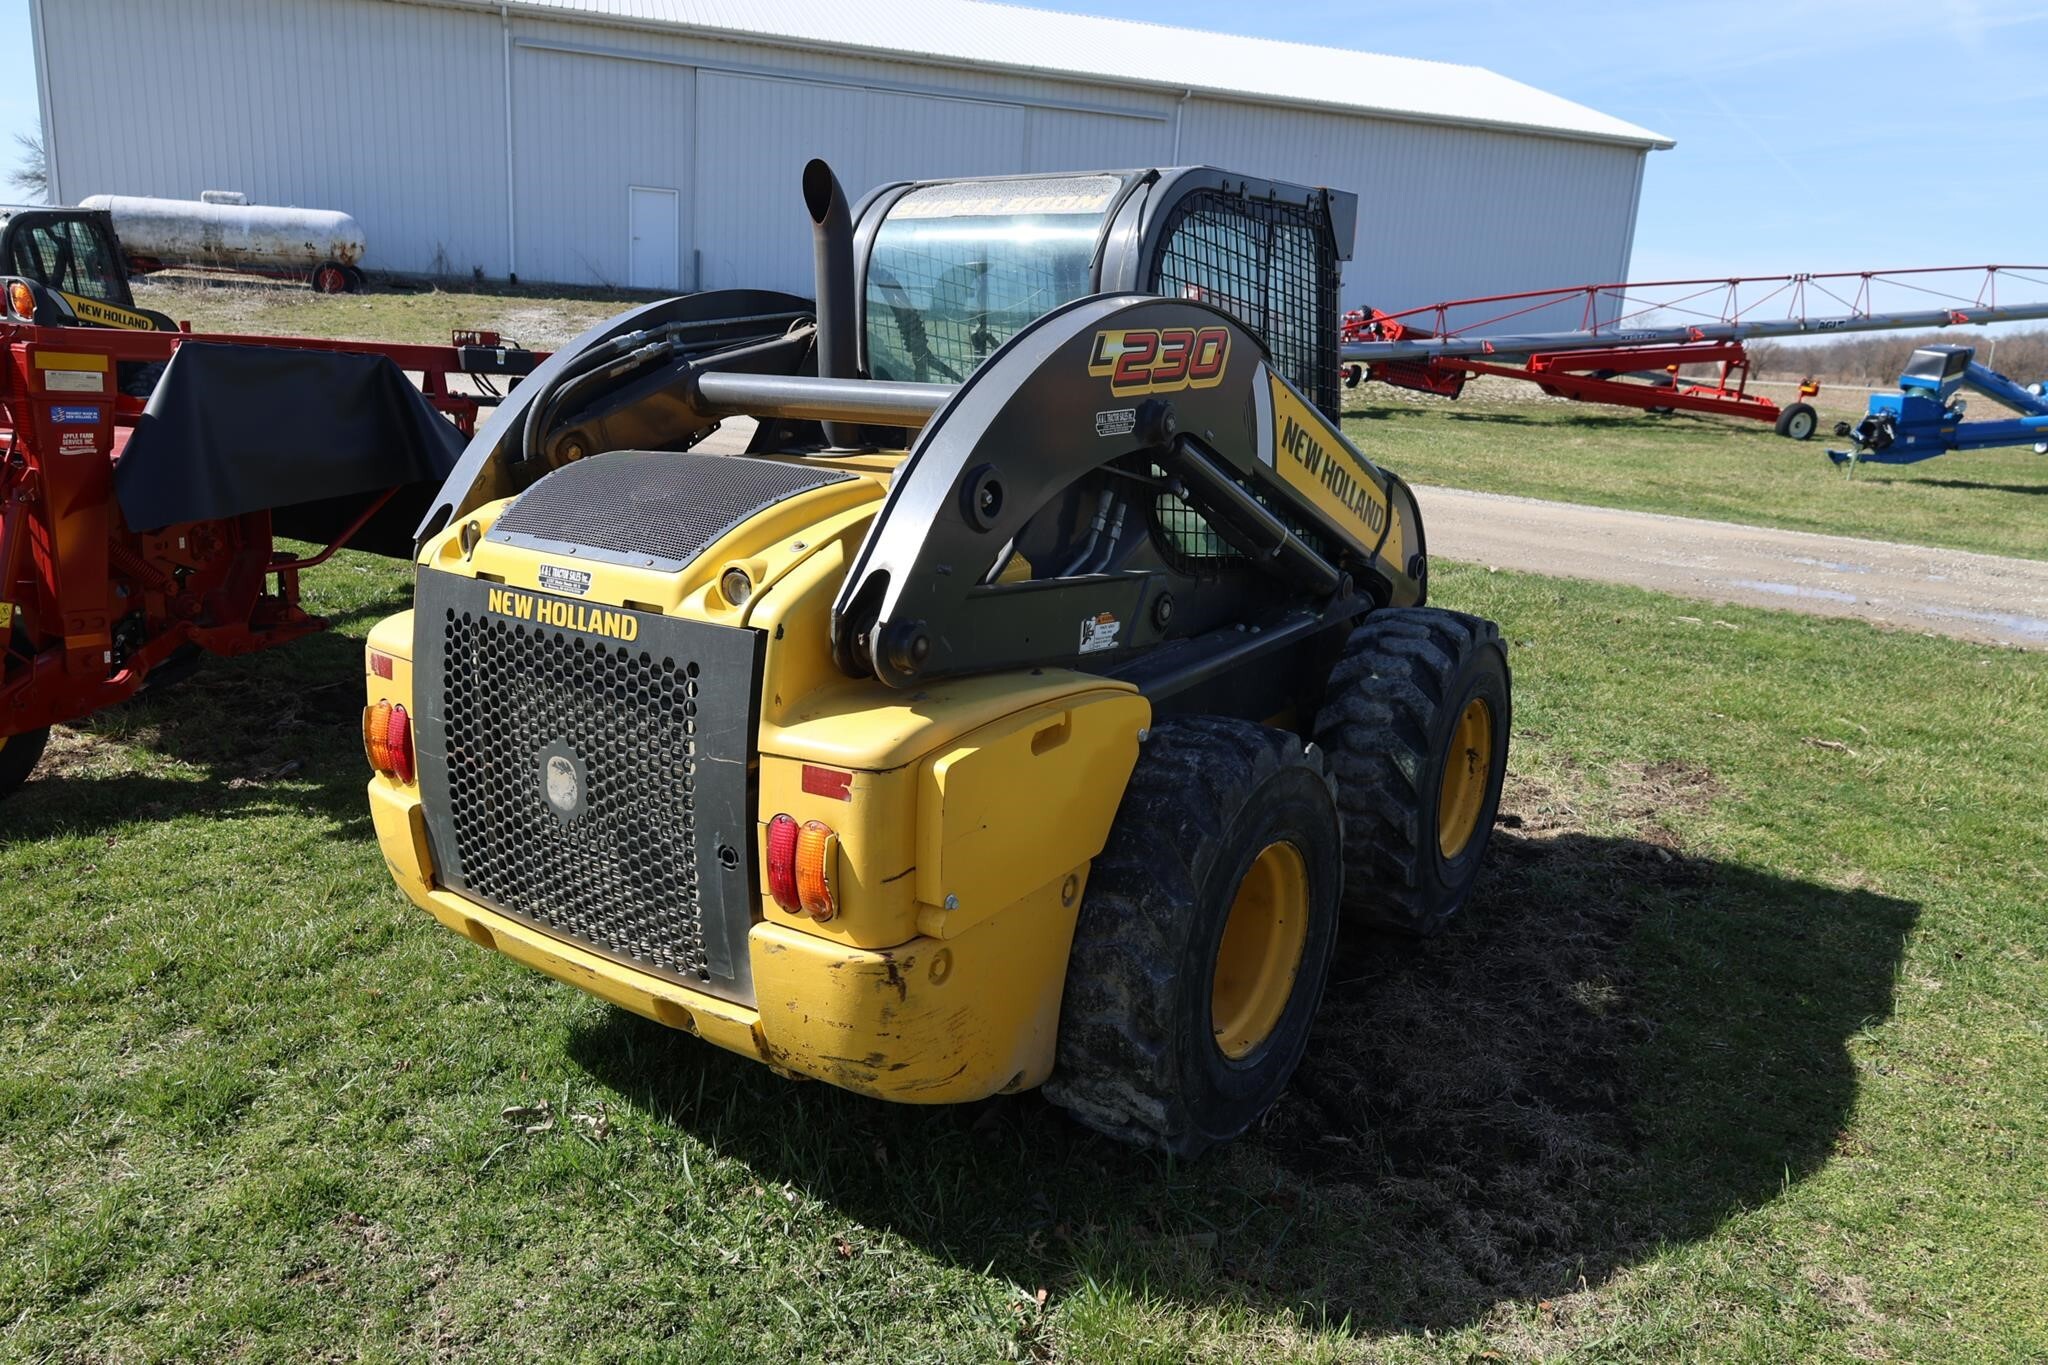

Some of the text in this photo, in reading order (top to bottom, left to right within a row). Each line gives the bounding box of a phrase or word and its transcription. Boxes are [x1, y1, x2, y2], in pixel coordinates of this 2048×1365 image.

[1006, 194, 1111, 214] BOOM
[77, 302, 149, 330] NEW HOLLAND
[1088, 326, 1231, 398] L230
[1281, 416, 1384, 534] NEW HOLLAND
[552, 568, 570, 580] TRACTOR
[570, 570, 582, 582] SALES
[488, 588, 638, 642] NEW HOLLAND
